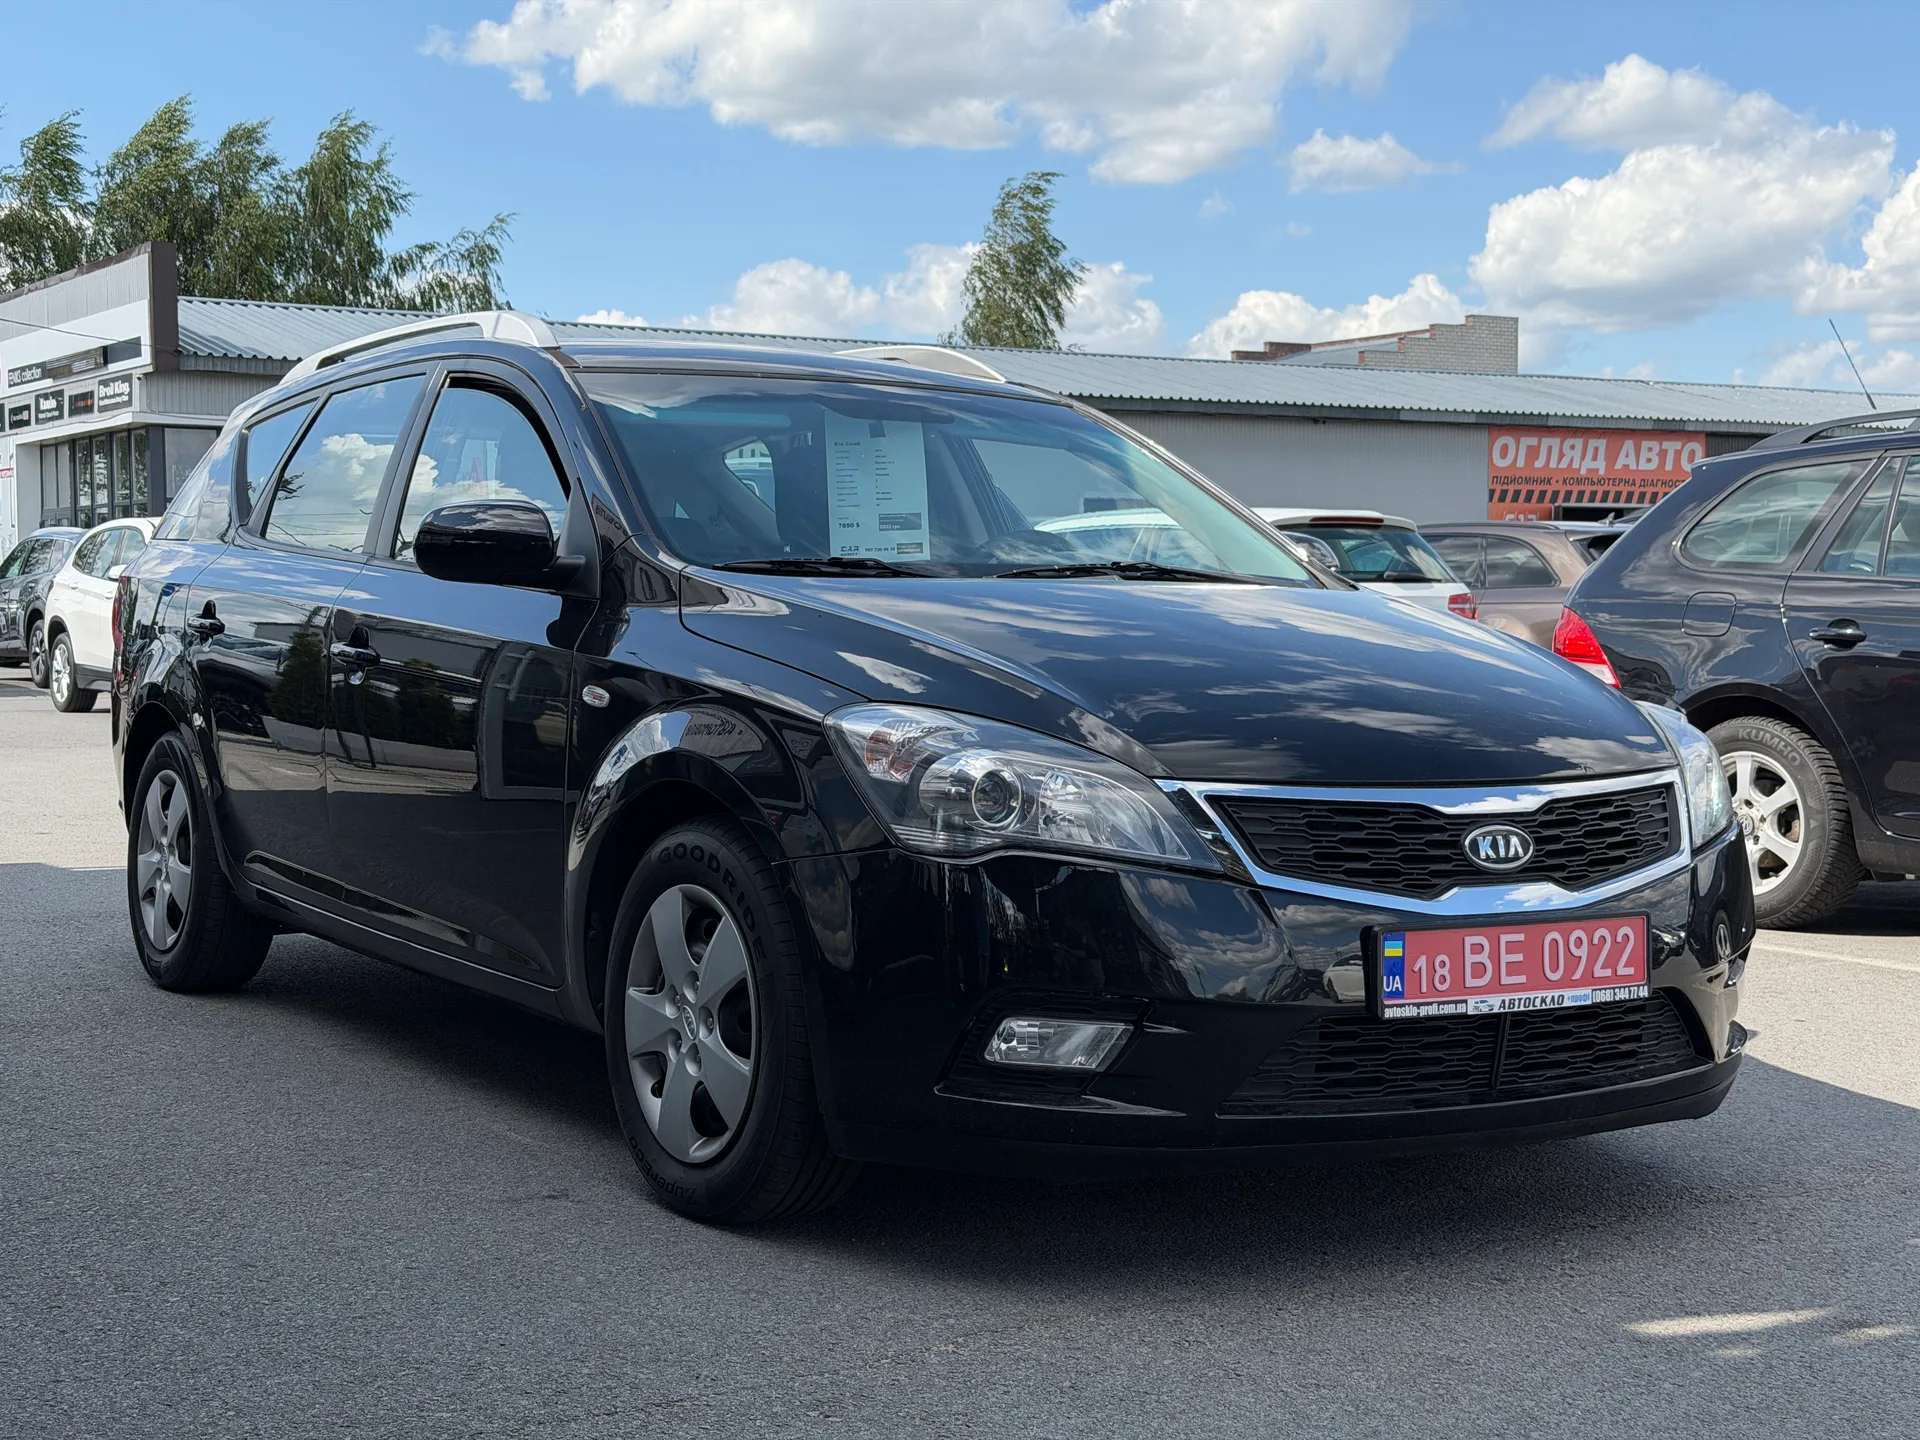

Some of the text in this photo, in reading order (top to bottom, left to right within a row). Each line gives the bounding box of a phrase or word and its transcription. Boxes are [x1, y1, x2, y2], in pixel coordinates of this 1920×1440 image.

[1492, 435, 1703, 475] ОГЛЯД АВТО
[1491, 474, 1553, 486] ПІДЙОМНИК
[1738, 728, 1801, 766] KUMHO
[1476, 835, 1525, 860] KIA
[658, 842, 766, 963] GOODRIDE
[1411, 925, 1636, 993] 18 BE 0922
[1383, 975, 1403, 993] UA
[1592, 985, 1649, 1003] (068) 344 77 44
[1384, 1002, 1467, 1018] avtosklo-profi.com.ua
[1498, 993, 1566, 1011] АВТОСКЛО
